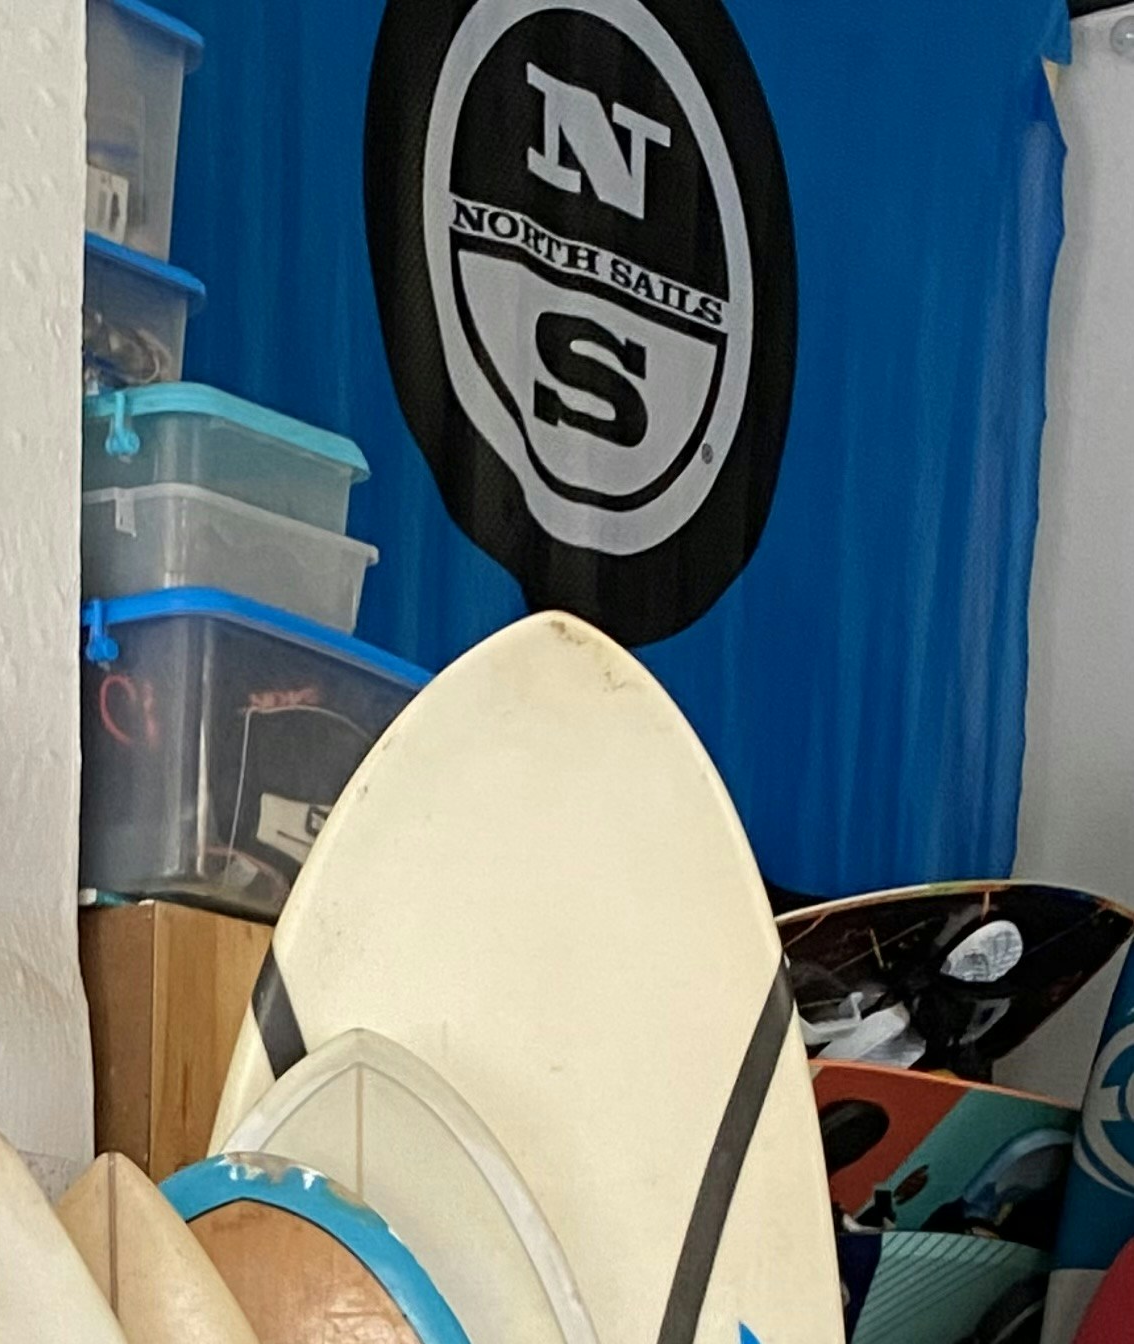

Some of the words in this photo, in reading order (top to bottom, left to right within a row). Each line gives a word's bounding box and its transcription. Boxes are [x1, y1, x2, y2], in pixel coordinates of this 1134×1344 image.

[526, 61, 671, 220] N
[452, 199, 599, 276] NORTH
[609, 256, 723, 326] SAILS
[533, 311, 648, 448] S
